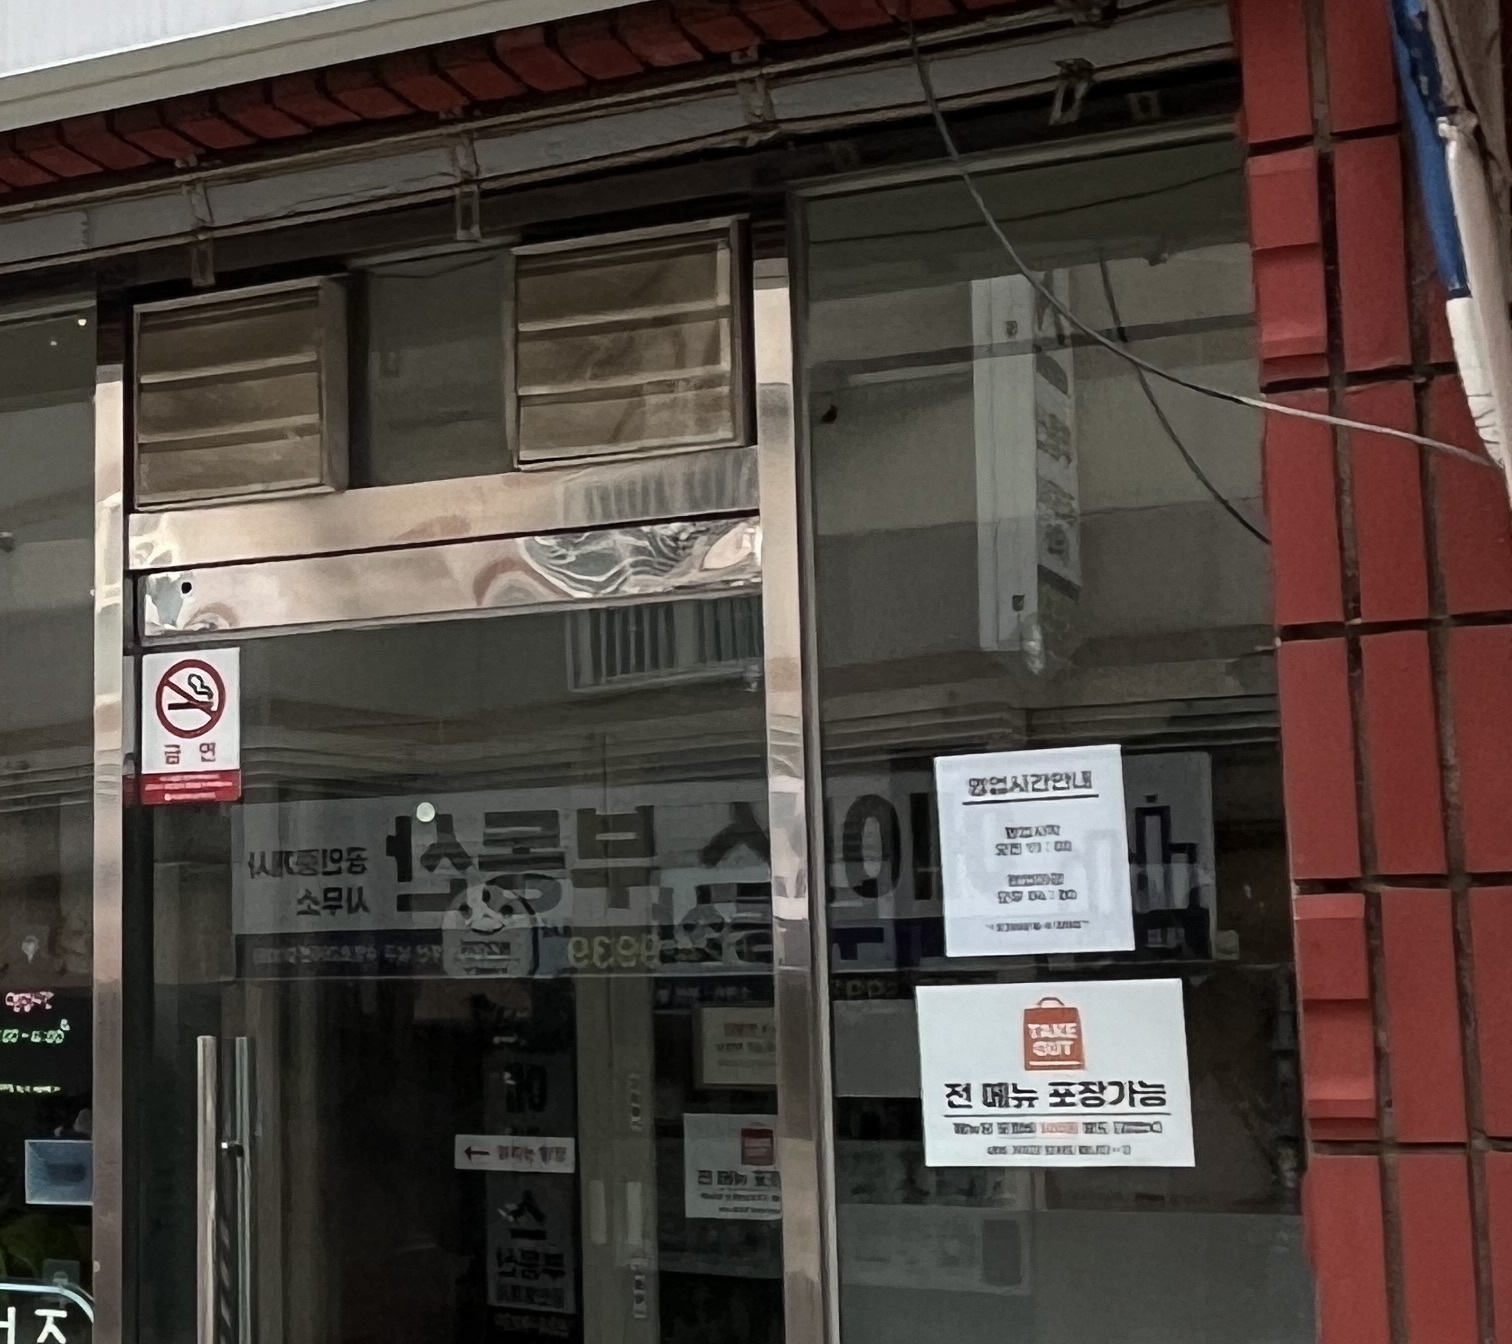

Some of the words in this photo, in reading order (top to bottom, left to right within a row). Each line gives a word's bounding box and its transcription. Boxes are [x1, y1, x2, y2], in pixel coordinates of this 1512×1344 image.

[1027, 1022, 1078, 1040] TAKE
[1032, 1040, 1074, 1057] OUT
[944, 1082, 973, 1109] 전
[982, 1081, 1039, 1109] 메뉴
[1048, 1080, 1167, 1109] 포장가능
